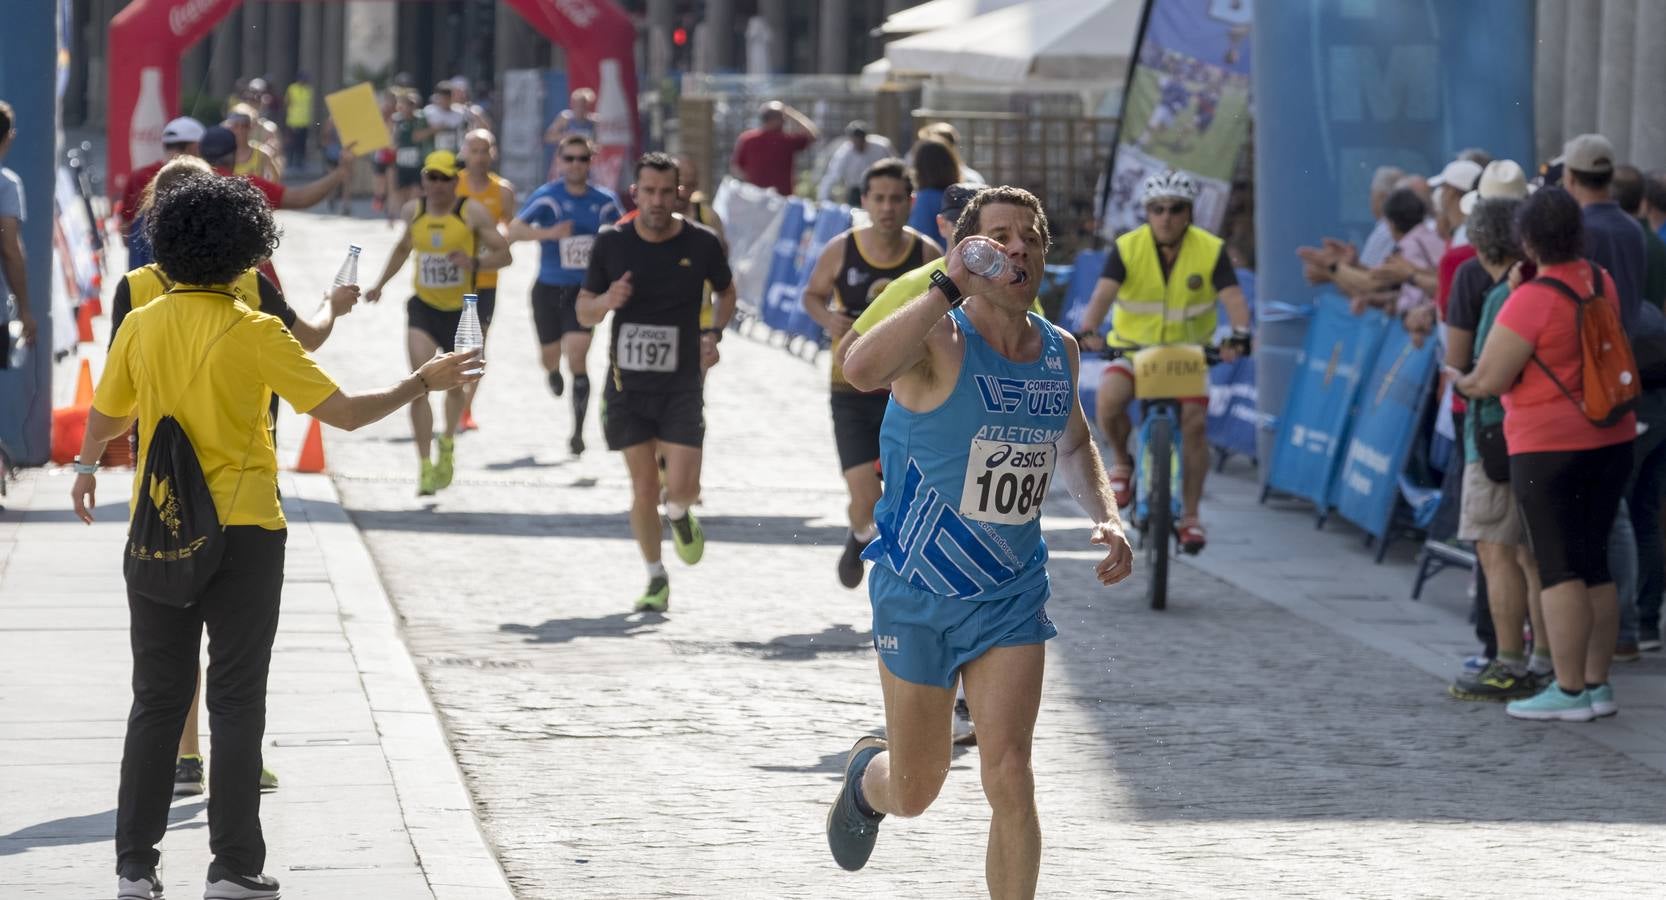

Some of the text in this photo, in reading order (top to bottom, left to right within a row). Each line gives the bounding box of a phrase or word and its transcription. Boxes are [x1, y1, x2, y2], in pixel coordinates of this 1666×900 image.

[421, 265, 460, 285] 1152
[624, 341, 671, 366] 1197
[1010, 451, 1047, 468] asics
[977, 470, 1049, 516] 1084
[878, 634, 898, 649] HH
